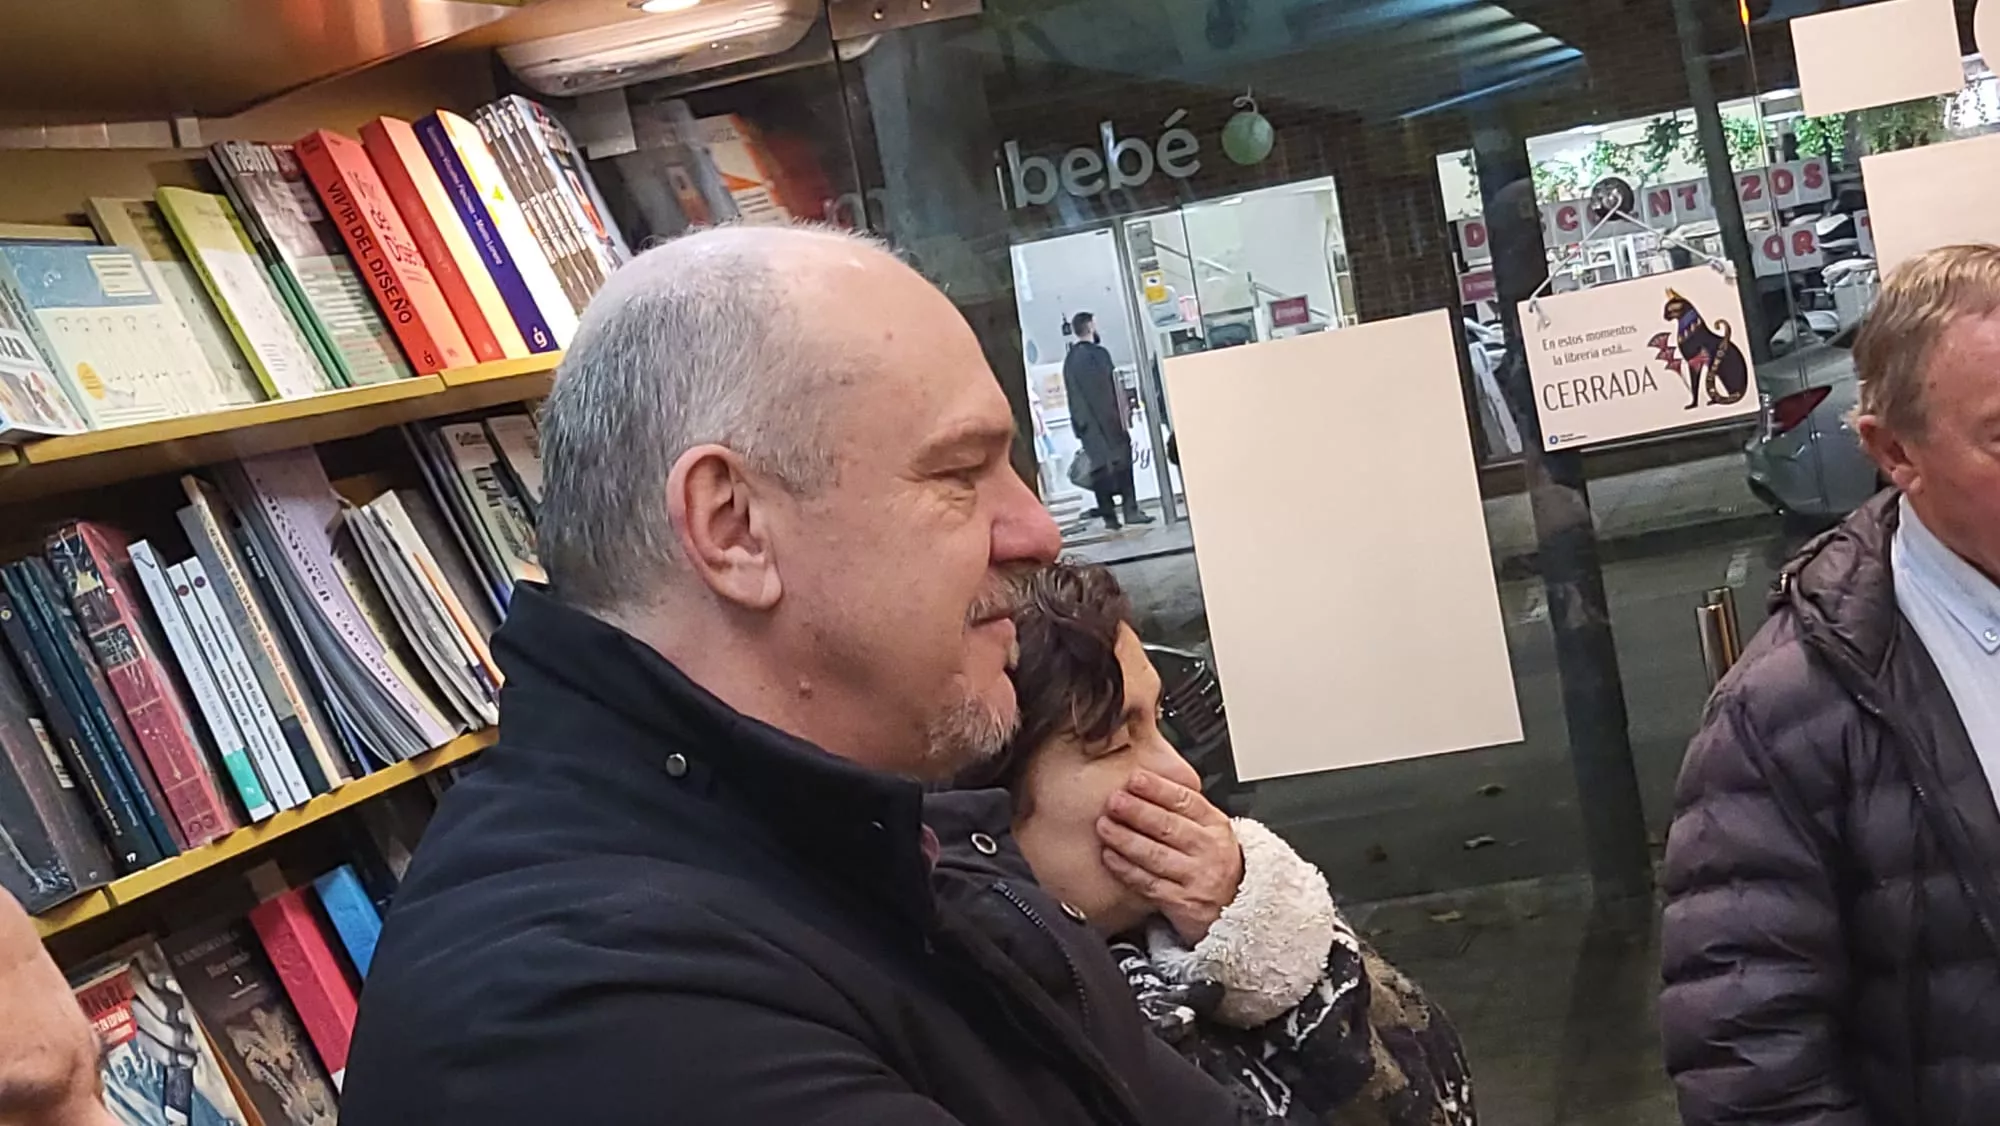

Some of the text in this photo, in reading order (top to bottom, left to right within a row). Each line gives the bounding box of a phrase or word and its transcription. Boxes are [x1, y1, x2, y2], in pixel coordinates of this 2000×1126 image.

[350, 225, 385, 261] DEL
[368, 257, 413, 325] DISEÑO
[1542, 324, 1637, 351] En estos momentos
[1552, 354, 1562, 366] la
[1543, 365, 1658, 411] CERRADA
